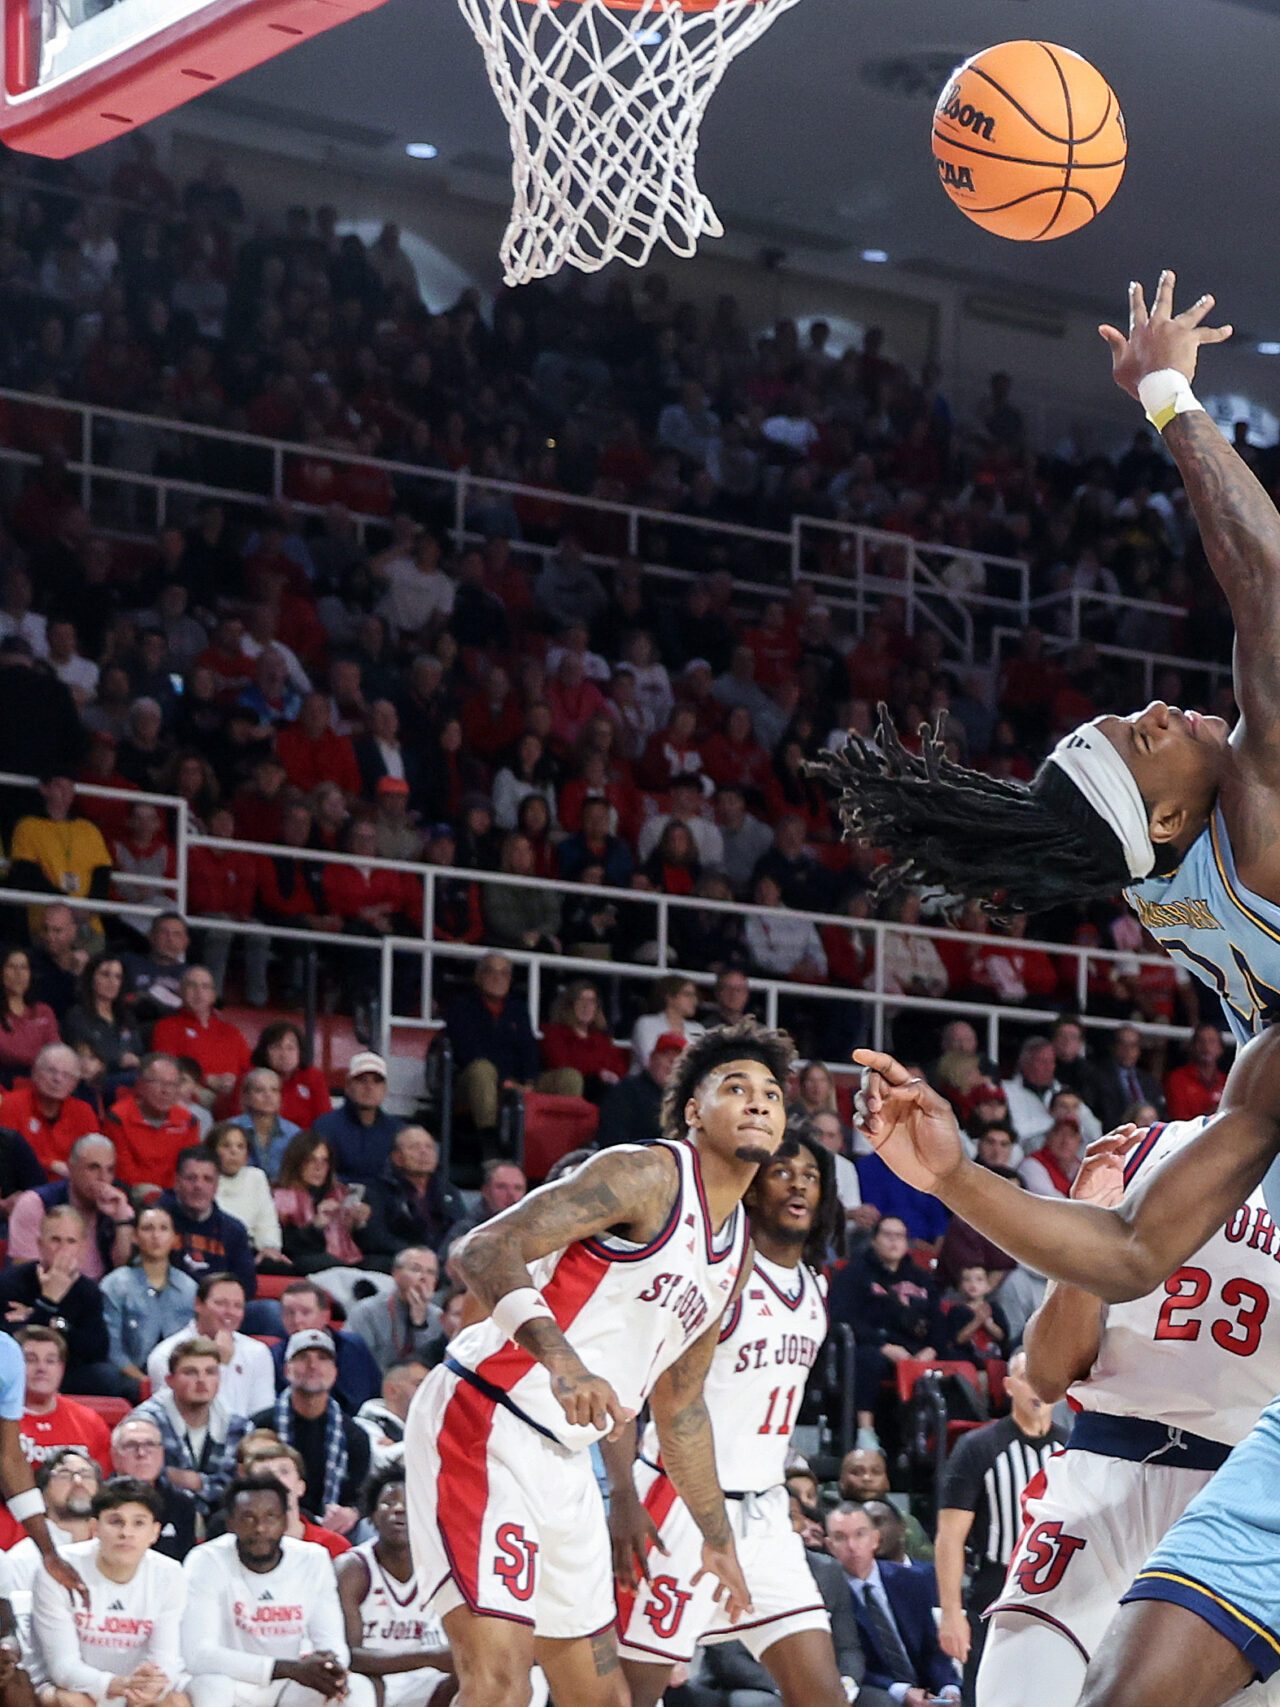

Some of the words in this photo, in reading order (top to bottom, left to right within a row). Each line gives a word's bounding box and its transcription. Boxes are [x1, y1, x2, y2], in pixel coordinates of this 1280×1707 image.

[938, 158, 975, 192] CAA
[1154, 1266, 1270, 1357] 23
[757, 1385, 796, 1434] 11
